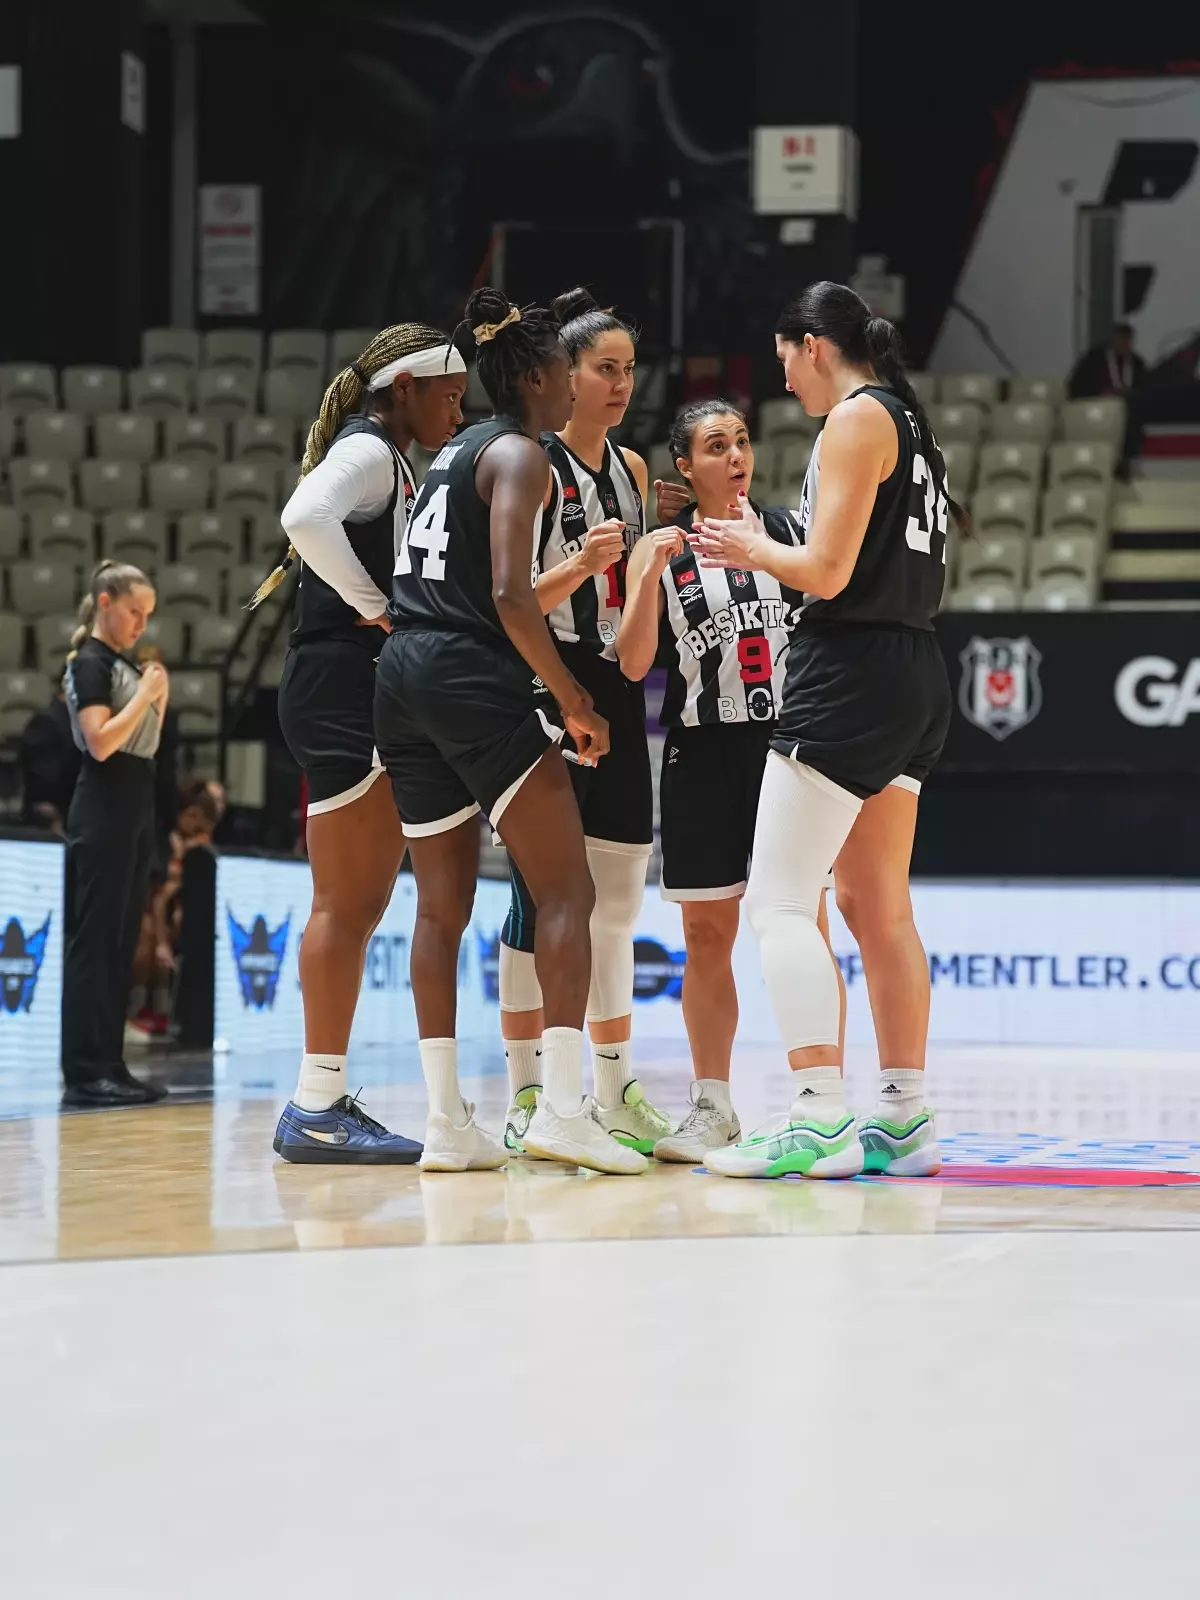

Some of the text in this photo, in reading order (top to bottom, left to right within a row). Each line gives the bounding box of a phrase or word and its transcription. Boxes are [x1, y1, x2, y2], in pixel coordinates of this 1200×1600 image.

[563, 513, 584, 523] umbro
[603, 562, 627, 608] 1
[682, 593, 703, 606] umbro
[737, 636, 772, 683] 9
